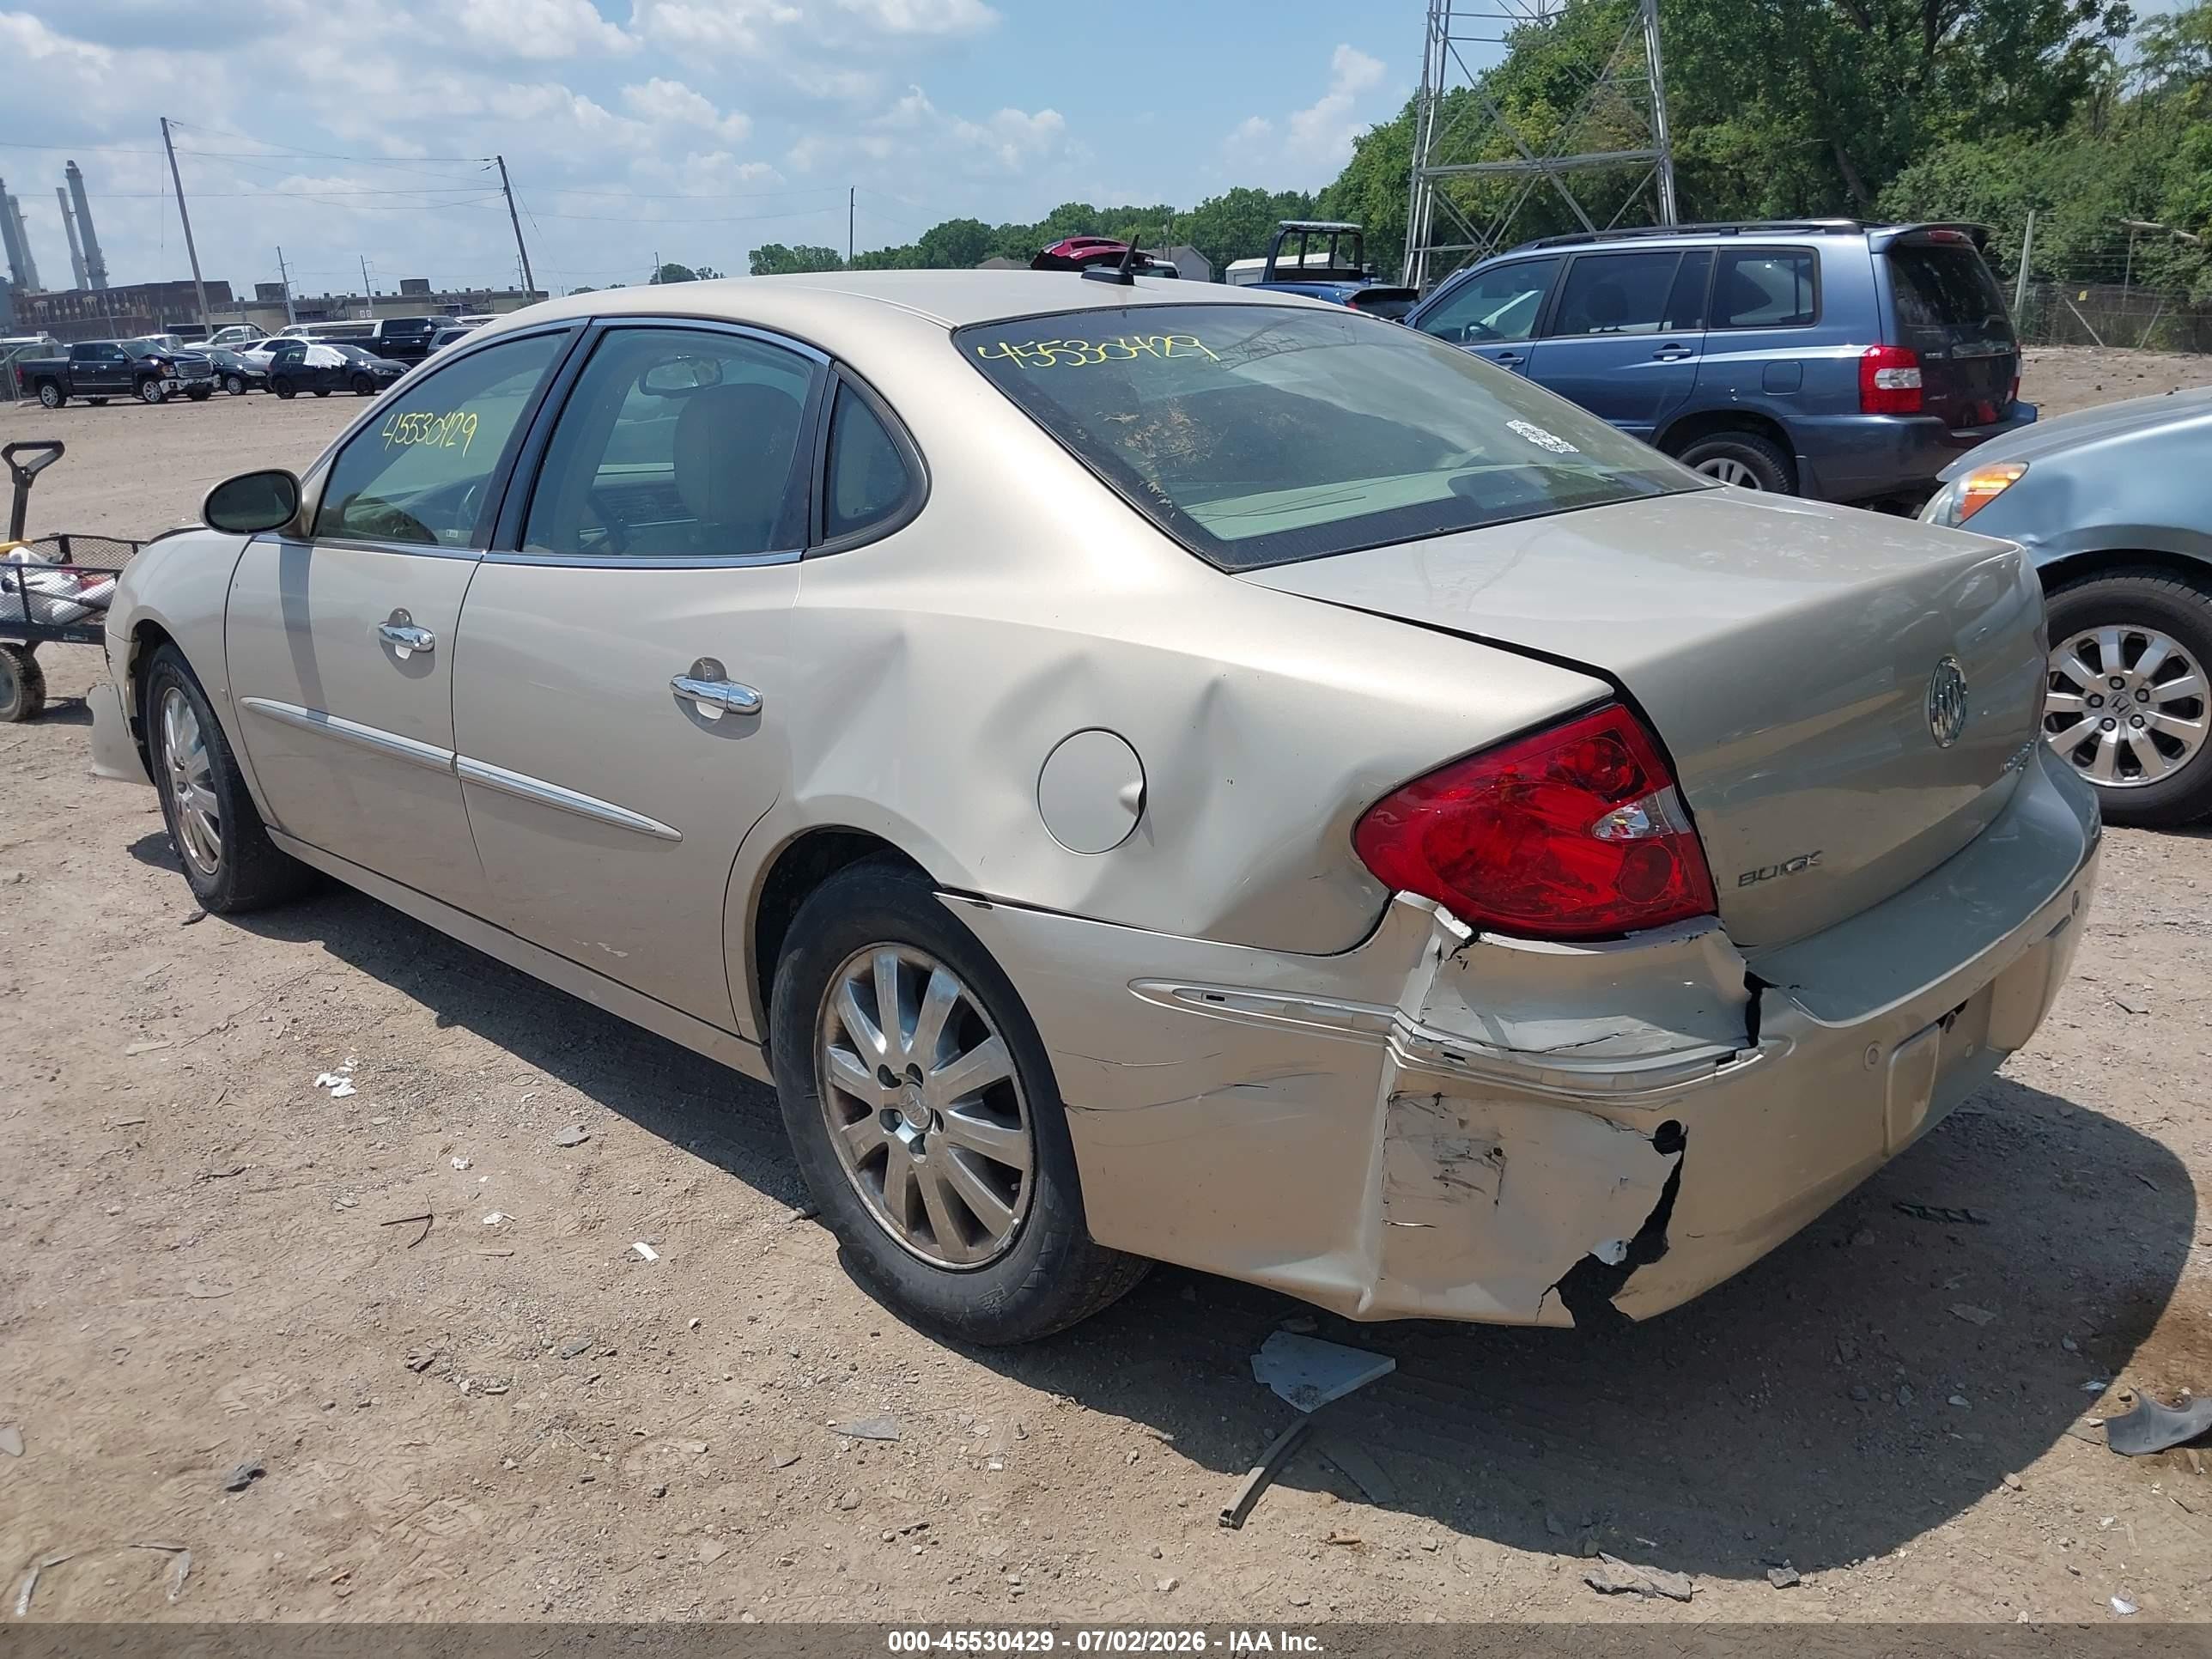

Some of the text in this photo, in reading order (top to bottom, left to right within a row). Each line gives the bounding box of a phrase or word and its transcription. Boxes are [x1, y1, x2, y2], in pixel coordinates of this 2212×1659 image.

[976, 335, 1221, 370] 45530429
[381, 411, 478, 459] 45530429
[1737, 849, 1824, 888] BUICK
